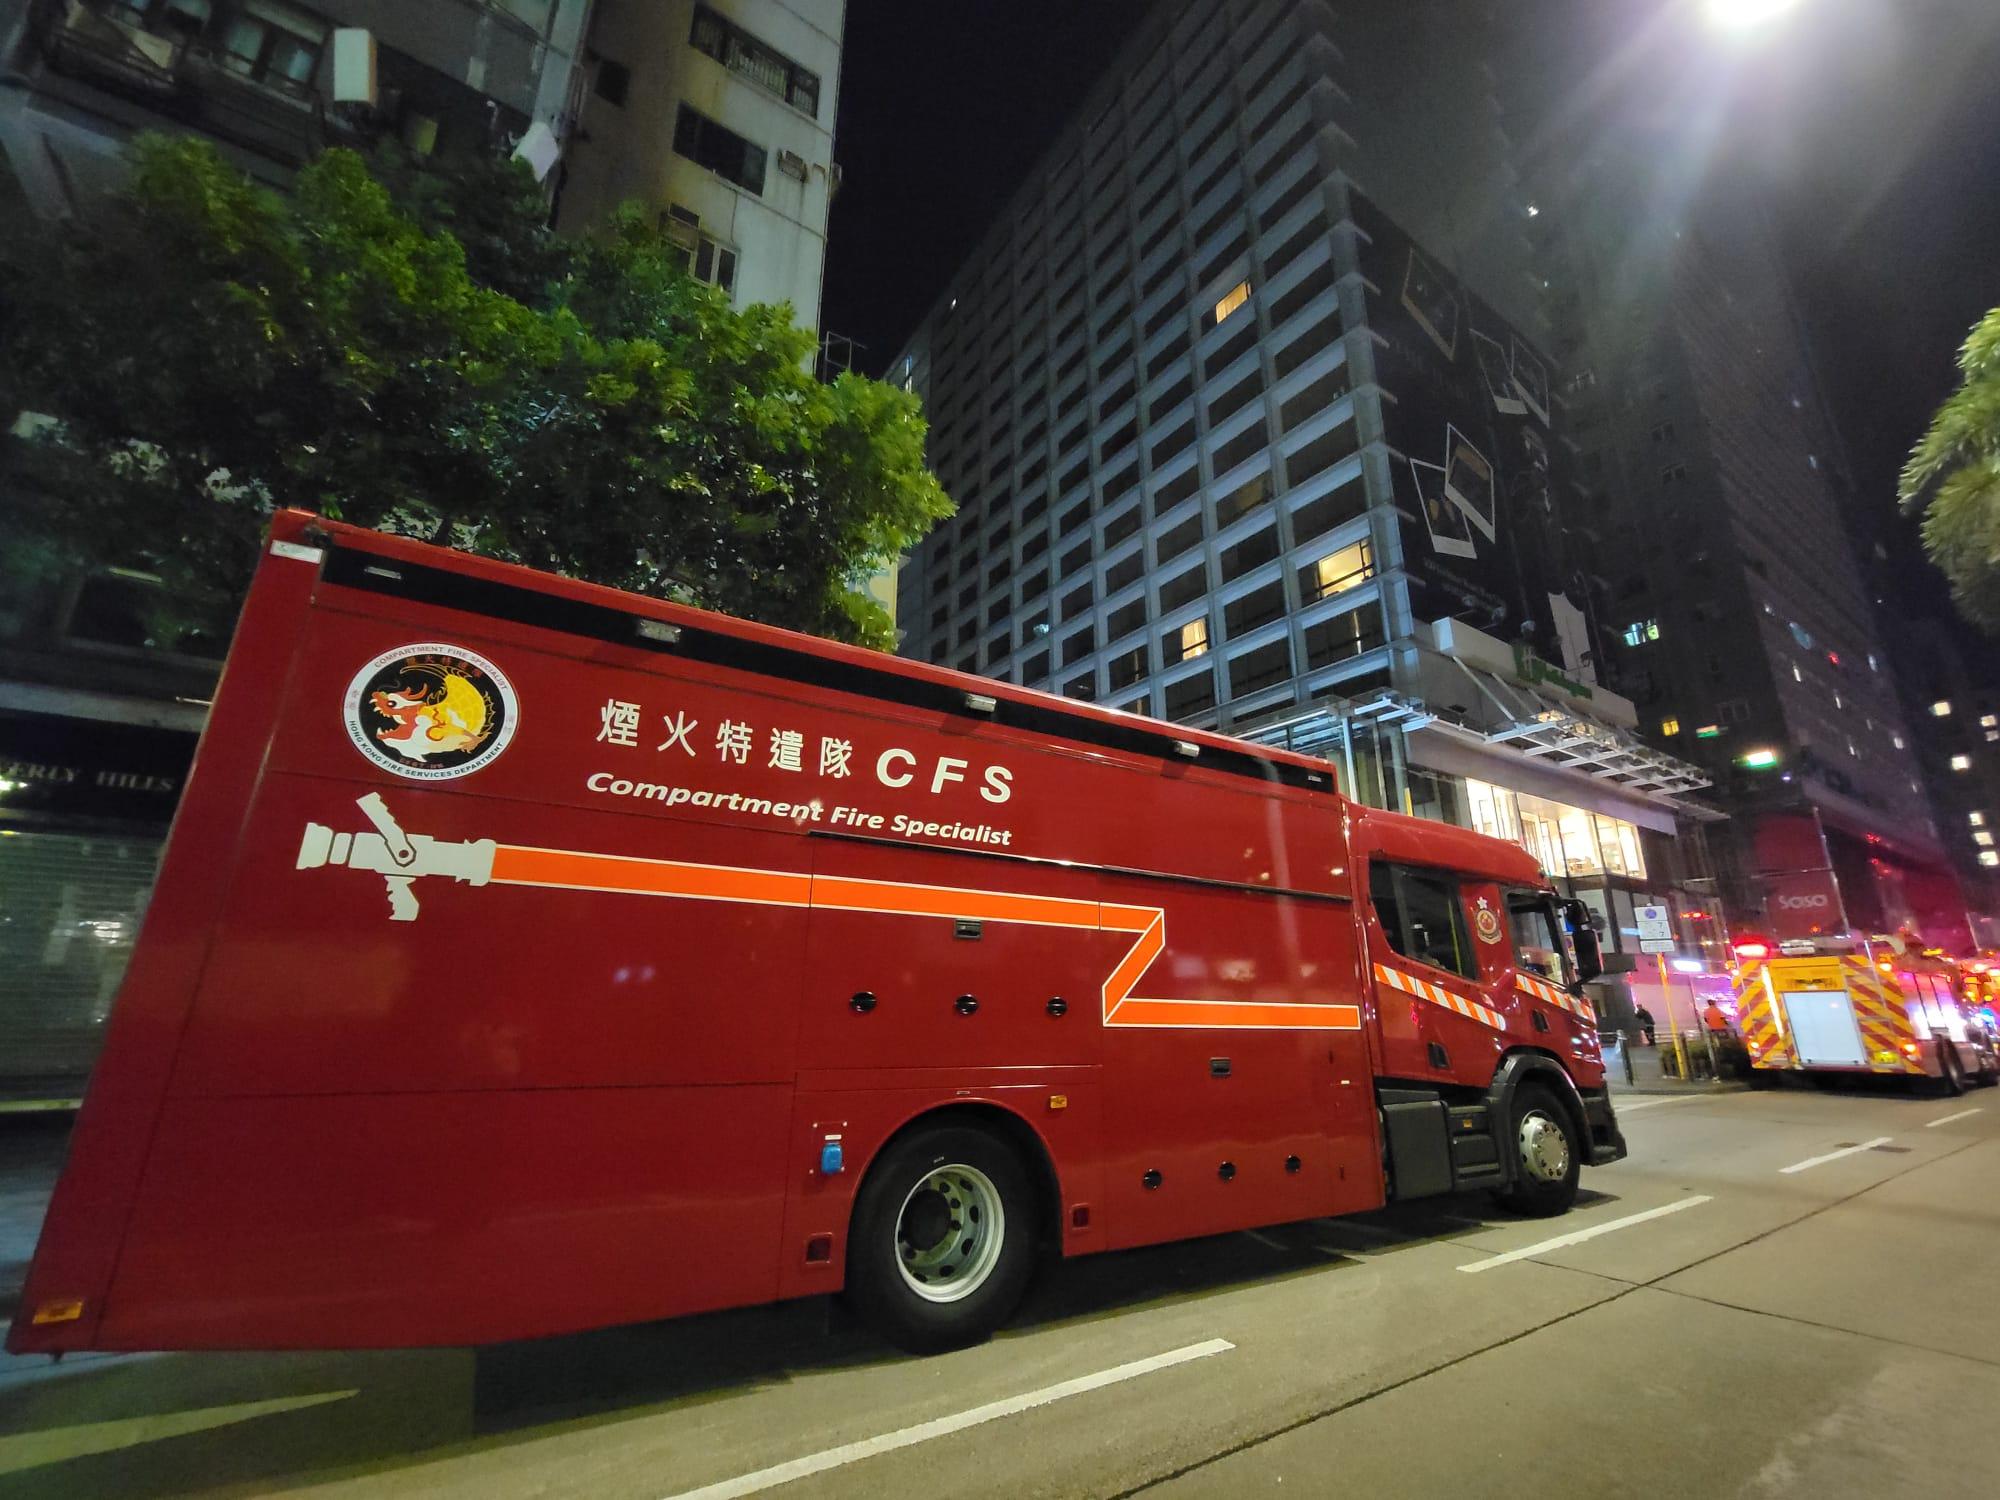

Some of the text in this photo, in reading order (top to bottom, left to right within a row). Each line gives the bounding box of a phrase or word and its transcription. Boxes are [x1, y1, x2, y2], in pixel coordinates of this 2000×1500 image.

[374, 646, 444, 668] COMPARTMENT
[349, 720, 364, 743] HONG
[360, 742, 383, 762] KONG
[382, 760, 403, 772] FIRE
[405, 769, 453, 778] SERVICES
[454, 742, 504, 775] DEPARTMENT
[596, 698, 853, 779] 煙火特遣隊
[876, 748, 1014, 803] CFS
[586, 772, 1012, 846] Compartment Fire Specialist
